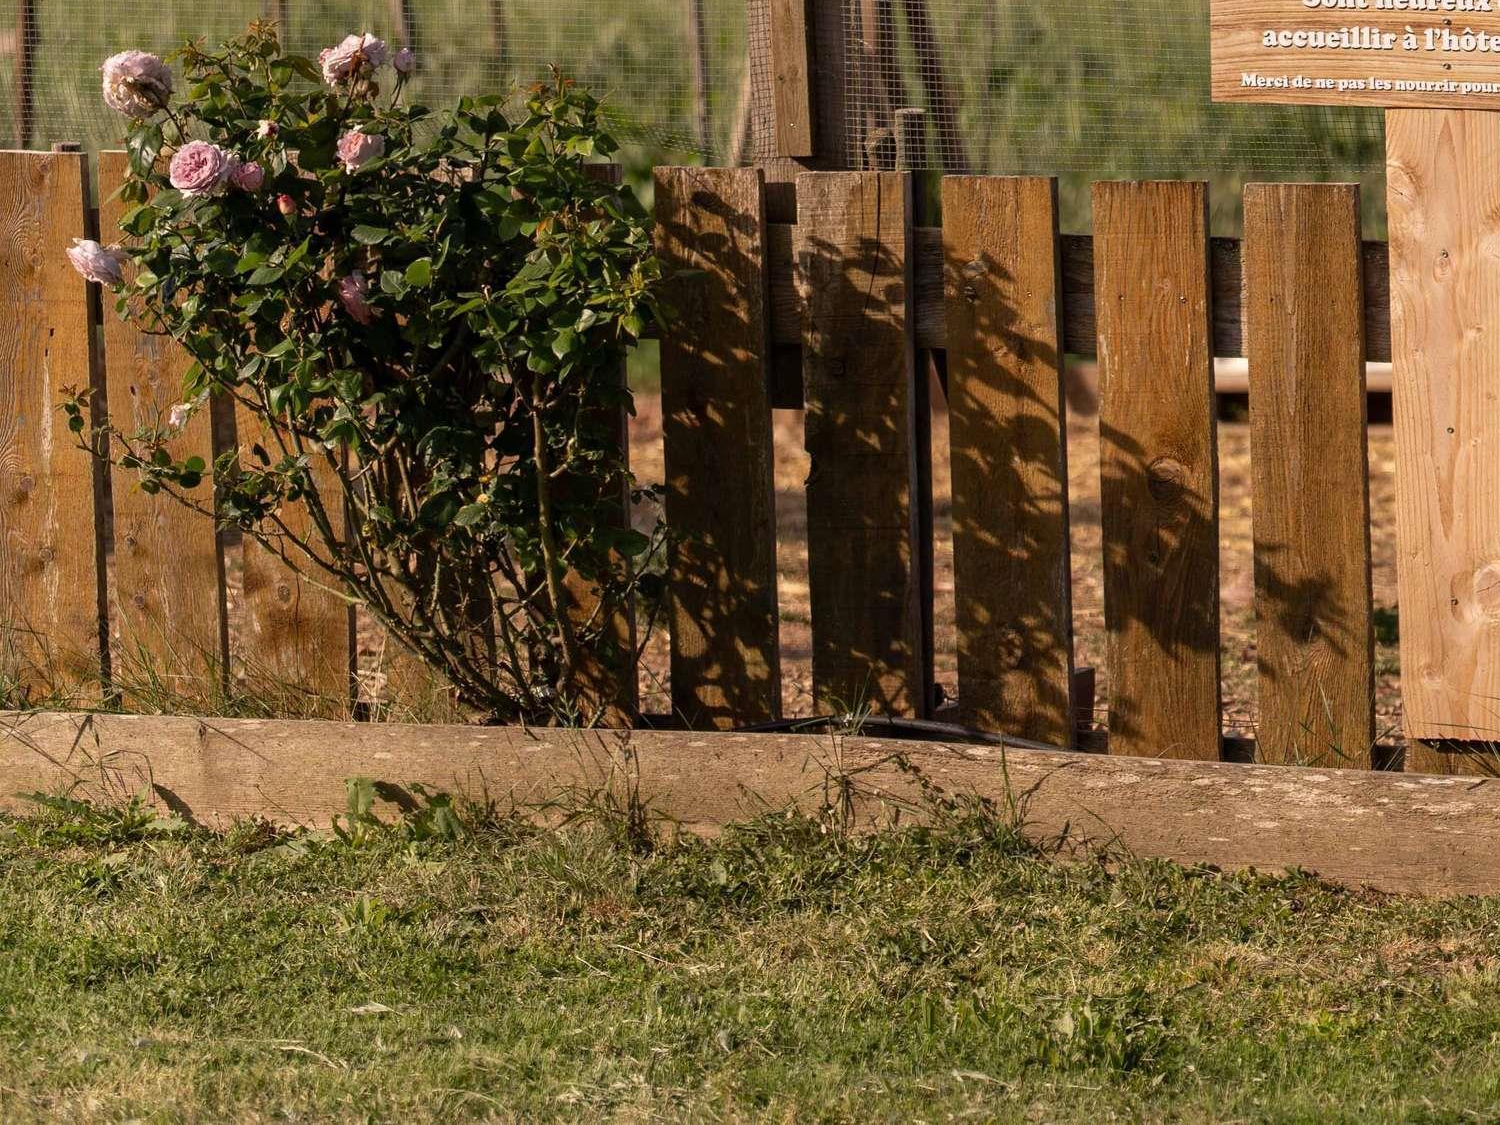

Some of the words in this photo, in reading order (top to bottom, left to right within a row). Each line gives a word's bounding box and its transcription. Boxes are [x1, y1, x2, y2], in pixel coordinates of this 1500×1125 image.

[1262, 26, 1397, 50] accueillir
[1402, 25, 1417, 51] à
[1241, 73, 1289, 89] Merci
[1292, 74, 1312, 89] de
[1315, 78, 1334, 89] ne
[1338, 78, 1366, 92] pas
[1369, 75, 1392, 90] les
[1395, 77, 1458, 92] nourrir
[1461, 81, 1500, 96] pour
